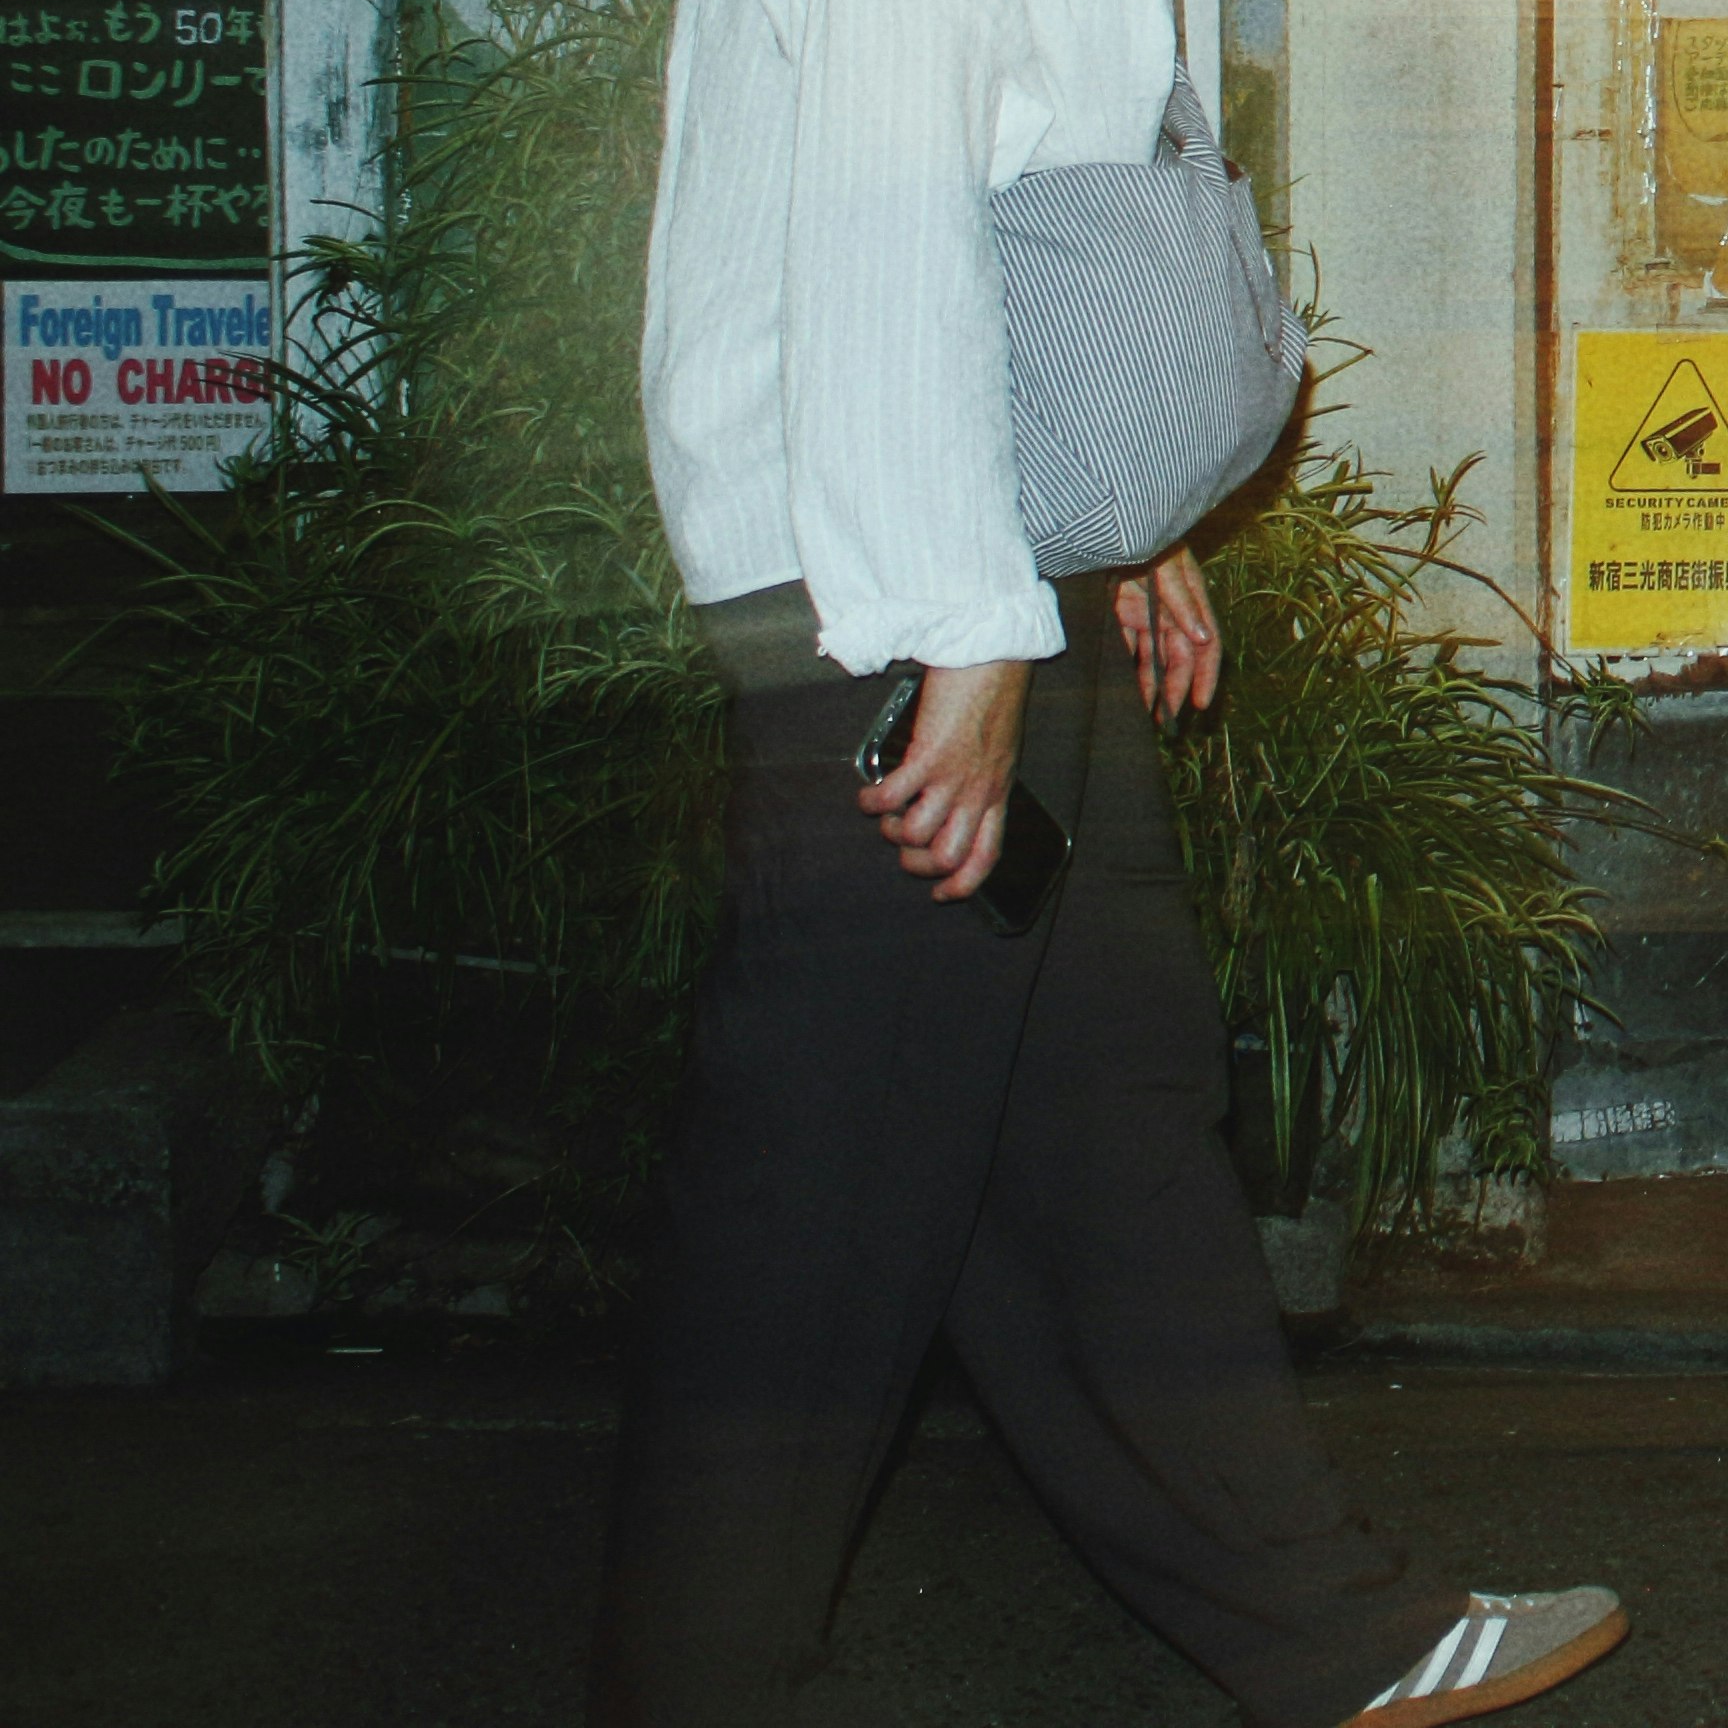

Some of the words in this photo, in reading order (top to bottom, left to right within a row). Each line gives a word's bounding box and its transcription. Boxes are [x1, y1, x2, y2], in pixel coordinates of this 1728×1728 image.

[20, 294, 142, 361] Foreign
[31, 358, 93, 405] NO
[1605, 497, 1685, 509] SECURITY
[1640, 511, 1726, 531] 防犯カメラ作動中
